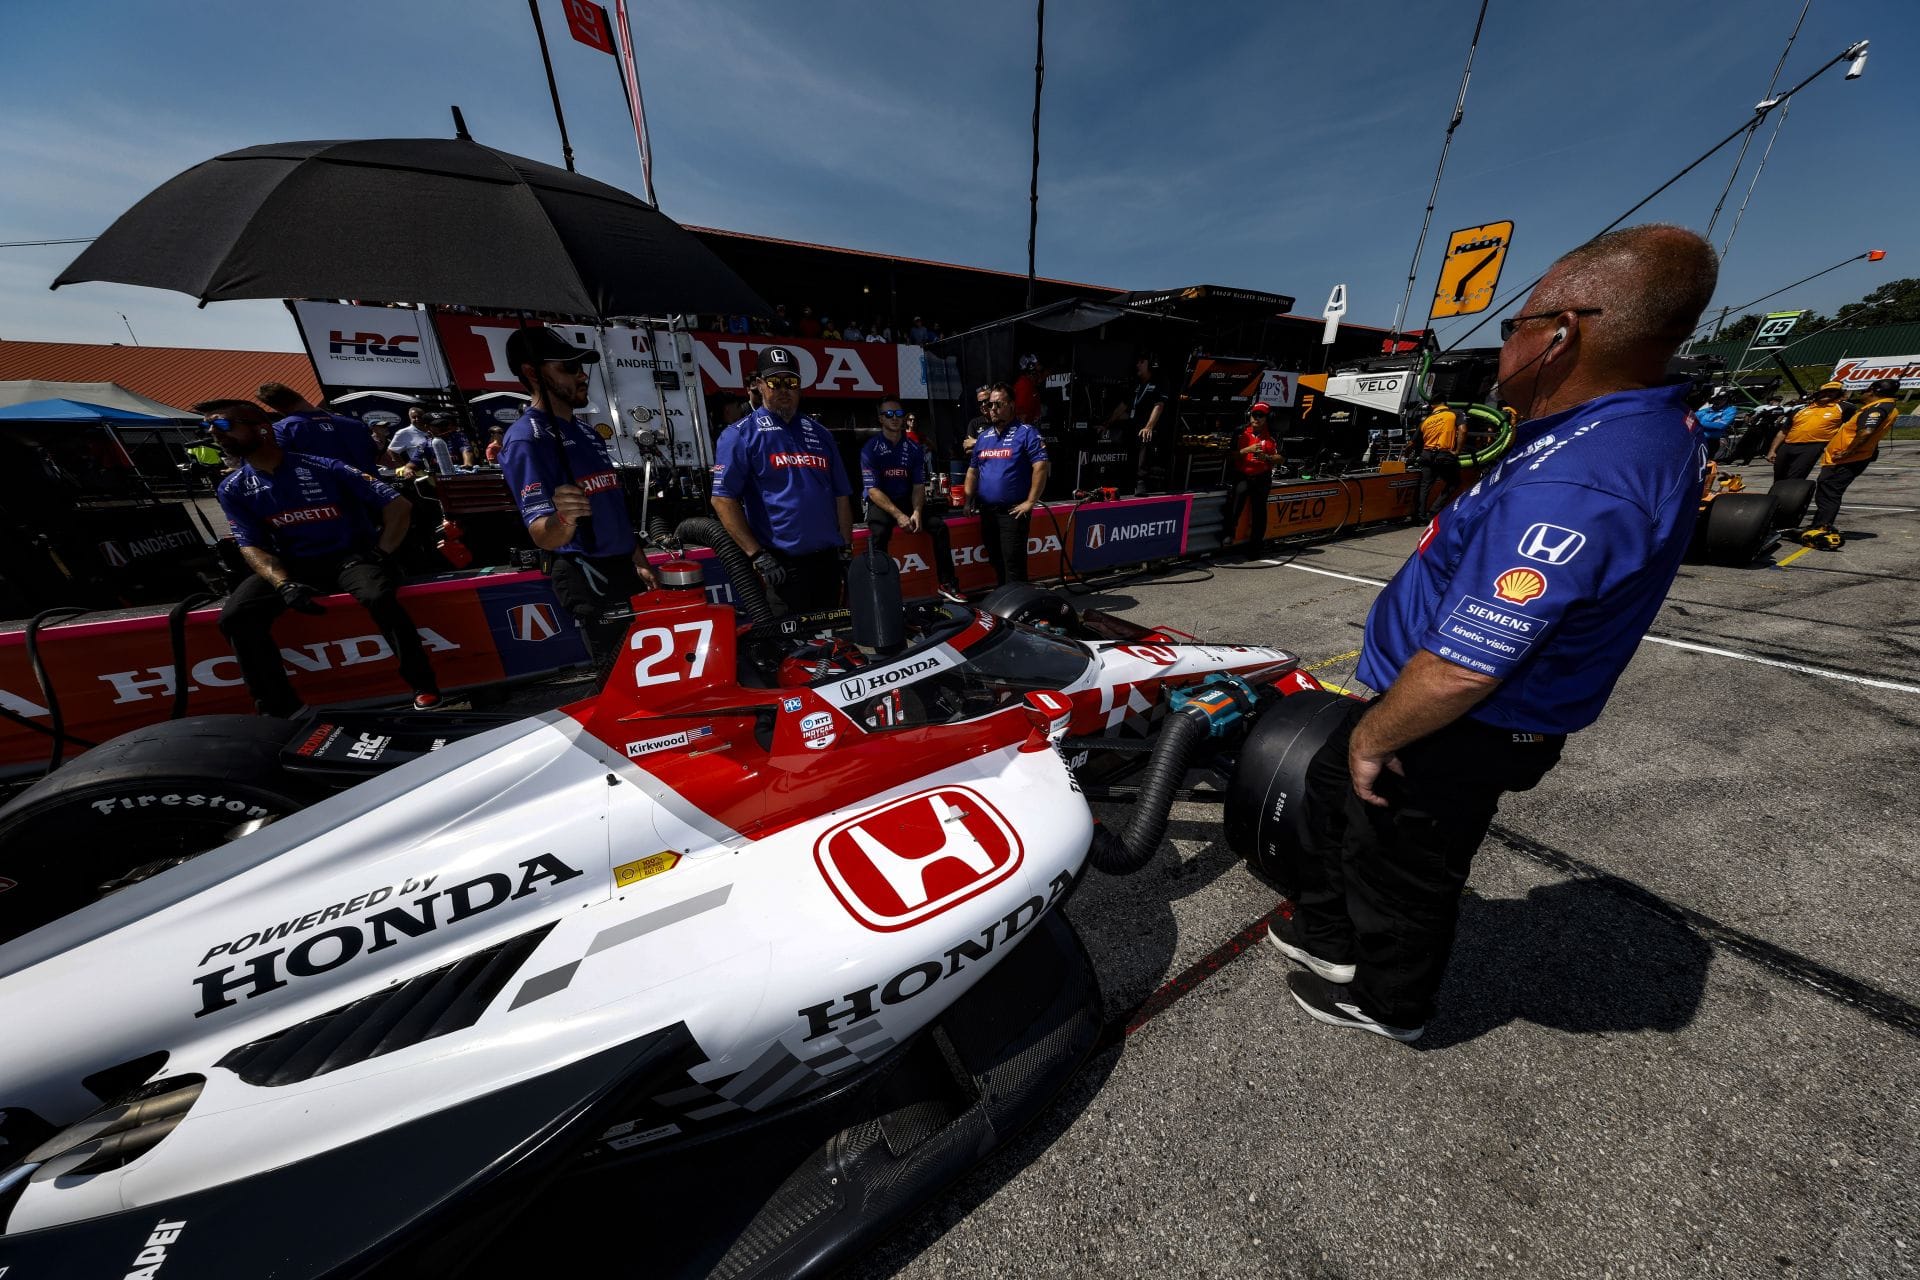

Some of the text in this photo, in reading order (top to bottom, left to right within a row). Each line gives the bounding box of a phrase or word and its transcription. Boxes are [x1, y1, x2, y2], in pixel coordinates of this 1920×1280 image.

[1762, 320, 1793, 335] 45
[330, 331, 419, 358] HRC
[616, 358, 673, 370] ANDRETTI
[1358, 379, 1398, 392] VELO
[775, 455, 826, 469] ANDRETTI
[1091, 453, 1128, 464] ANDRETTI
[1276, 498, 1327, 523] VELO
[128, 529, 197, 558] ANDRETTI
[1110, 519, 1176, 542] ANDRETTI
[1466, 604, 1532, 633] SIEMENS
[1452, 625, 1516, 654] kinetic vision
[630, 619, 714, 688] 27
[1450, 651, 1463, 660] SIX
[1471, 660, 1496, 674] APPAREL
[866, 657, 941, 690] HONDA
[295, 720, 335, 758] HONDA
[629, 734, 686, 756] Kirkwood
[802, 724, 834, 740] INDYCAR
[346, 732, 385, 760] HRC
[91, 792, 269, 818] Fireston
[198, 874, 439, 967] POWERED by
[192, 852, 584, 1019] HONDA
[798, 869, 1075, 1043] HONDA
[122, 1218, 188, 1280] APEI
